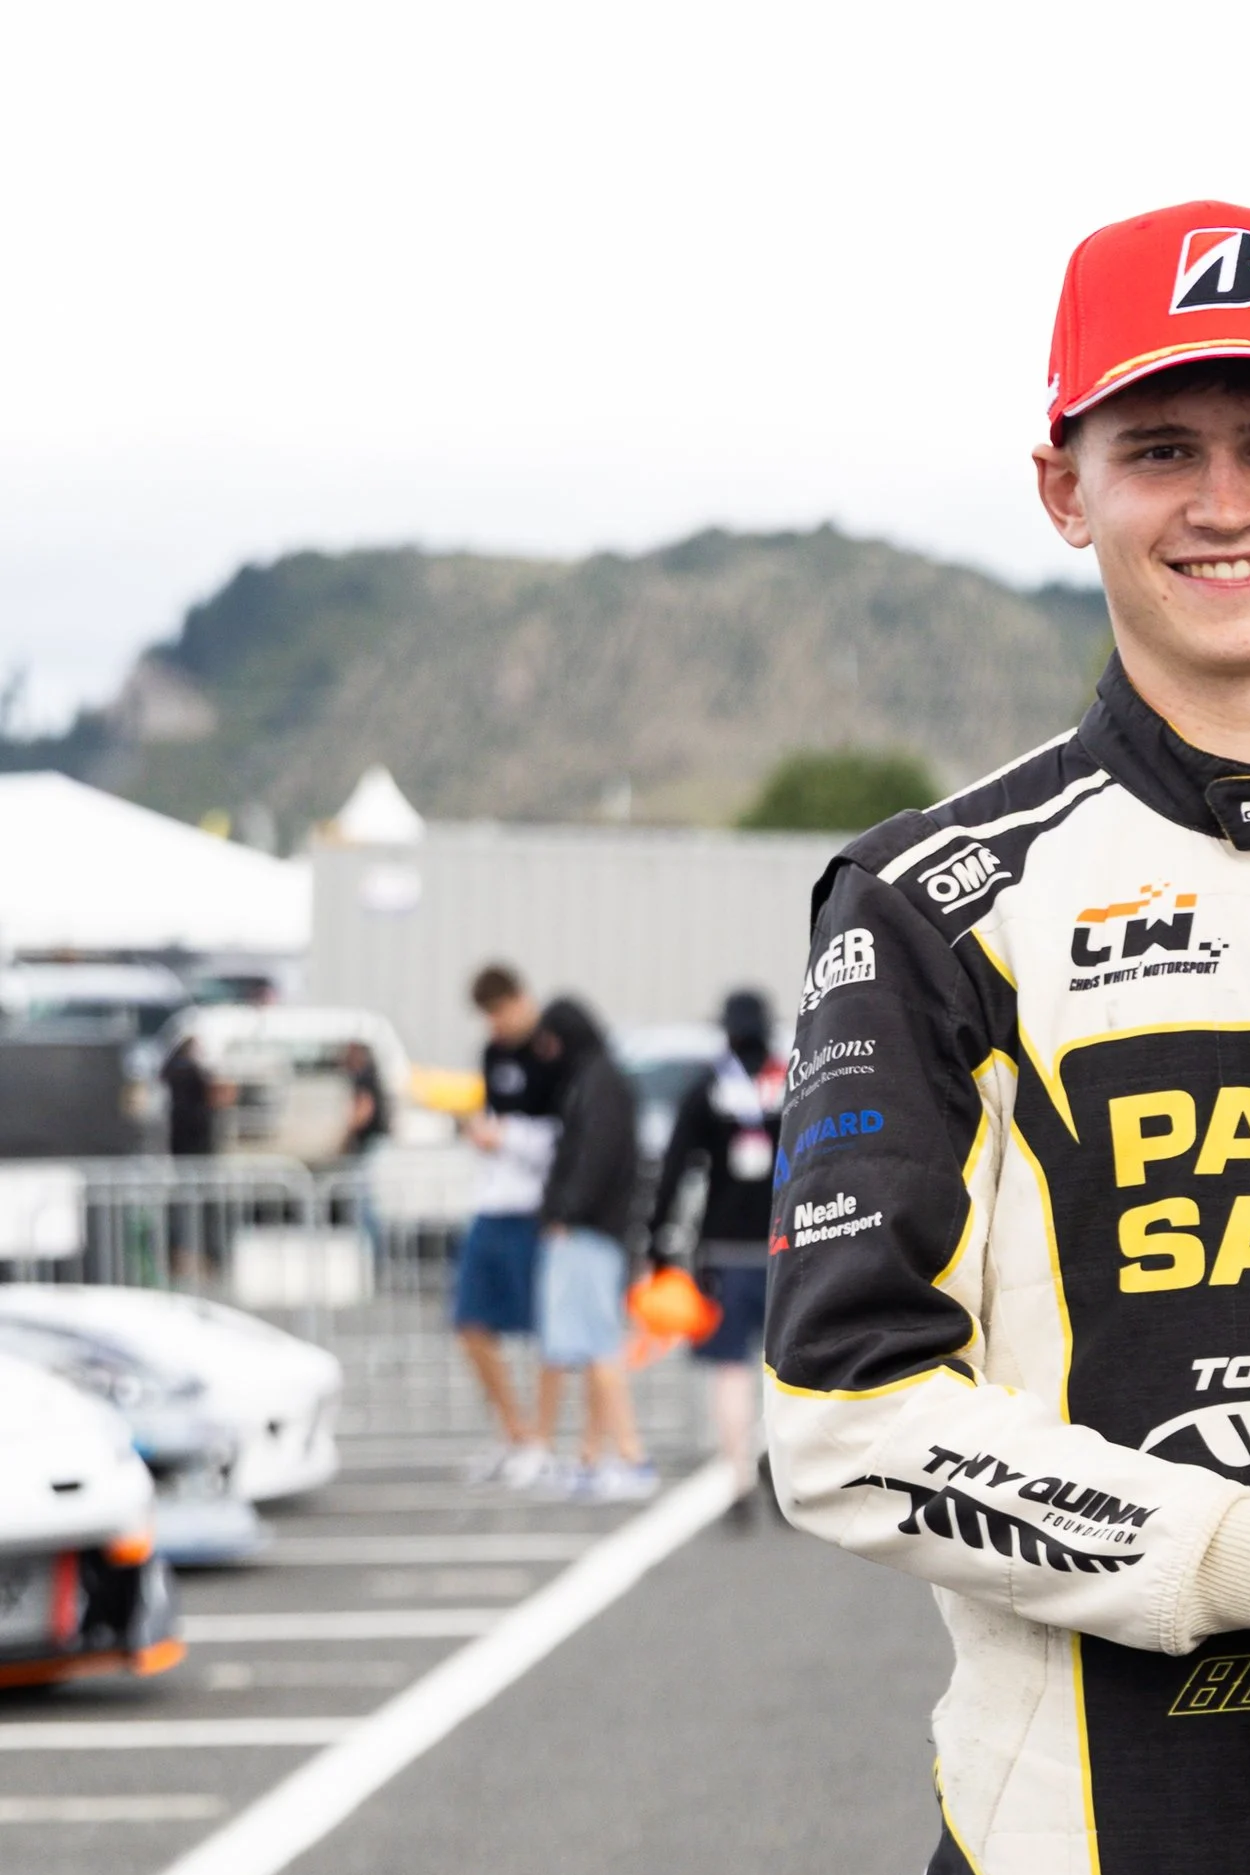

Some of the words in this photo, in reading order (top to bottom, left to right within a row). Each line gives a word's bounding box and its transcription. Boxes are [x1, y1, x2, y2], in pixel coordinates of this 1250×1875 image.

[1069, 975, 1101, 991] CHRIS
[1103, 967, 1139, 985] WHITE
[1142, 961, 1219, 978] MOTORSPORT
[794, 1192, 857, 1230] Neale
[794, 1211, 883, 1248] Motorsport
[1018, 1477, 1161, 1528] QUINN
[1042, 1512, 1137, 1545] FOUNDATION
